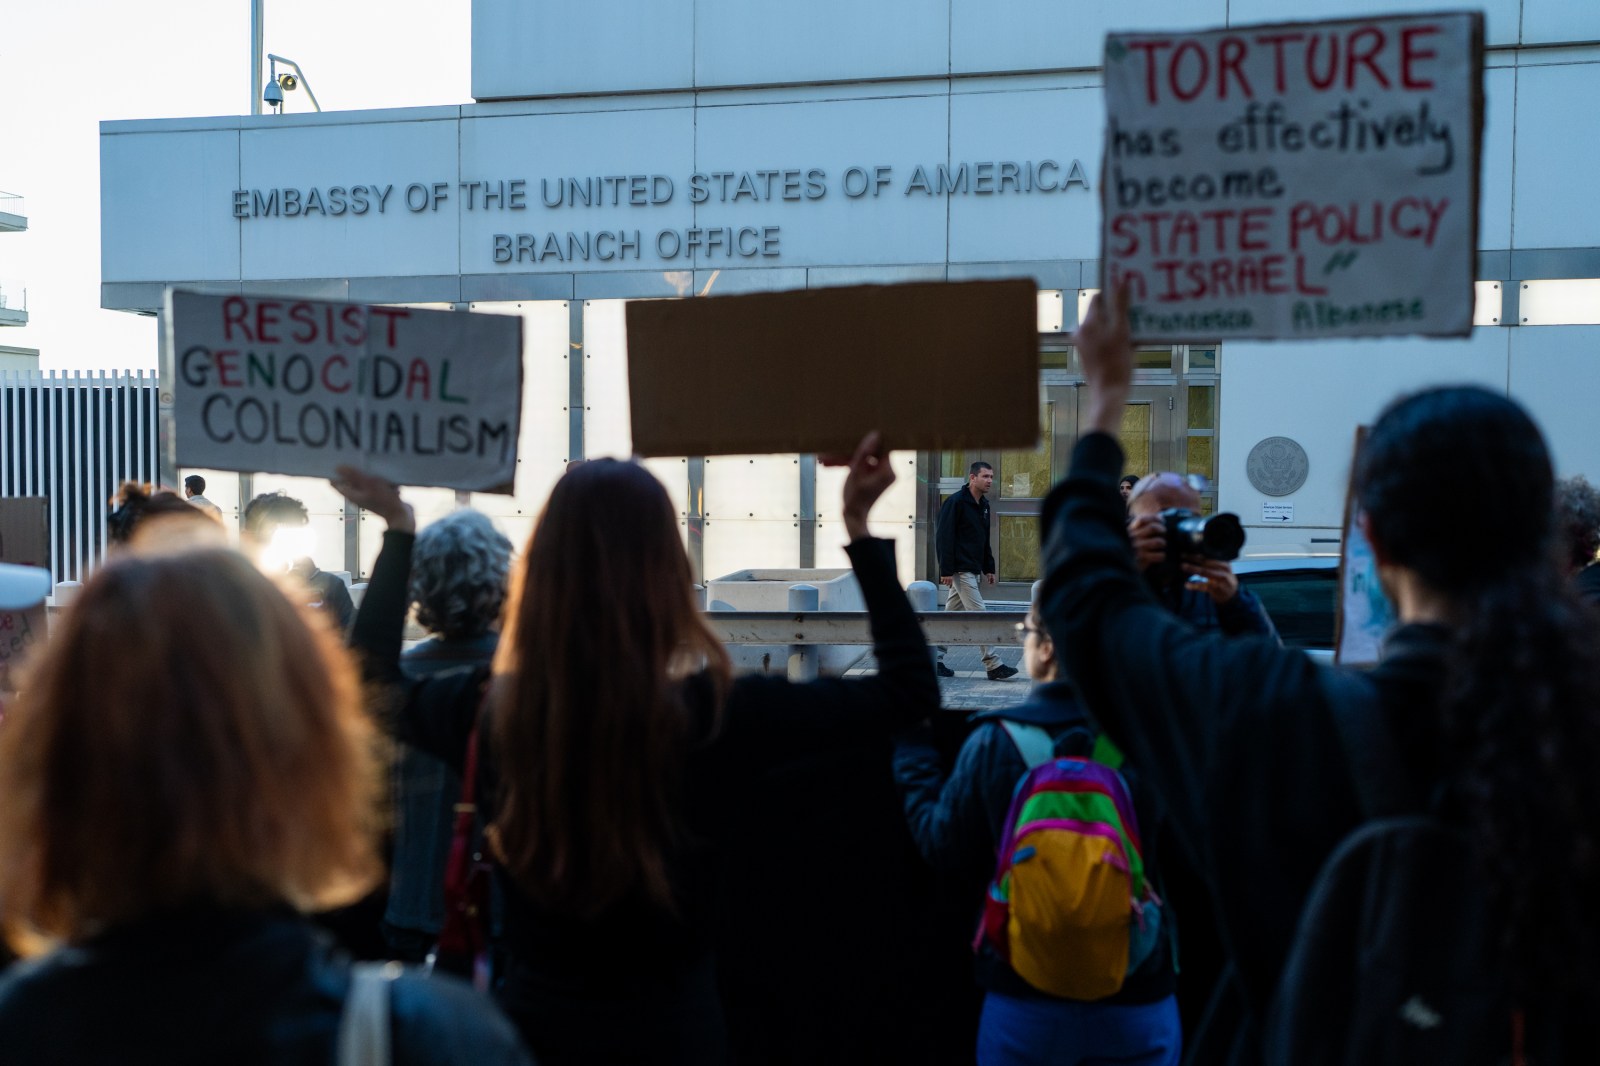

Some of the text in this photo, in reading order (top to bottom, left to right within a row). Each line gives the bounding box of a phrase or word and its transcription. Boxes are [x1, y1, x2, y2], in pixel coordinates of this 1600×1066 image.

[1109, 99, 1455, 176] has effectively
[232, 159, 1090, 218] EMBASSY OF THE UNITED STATES OF AMERICA
[1115, 166, 1284, 208] become
[492, 225, 780, 264] BRANCH OFFICE
[1110, 196, 1450, 260] STATE POLICY
[222, 295, 412, 348] RESIST
[1291, 298, 1425, 332] Albanese
[180, 344, 470, 405] GENOCIDAL
[202, 392, 511, 460] COLONIALISM
